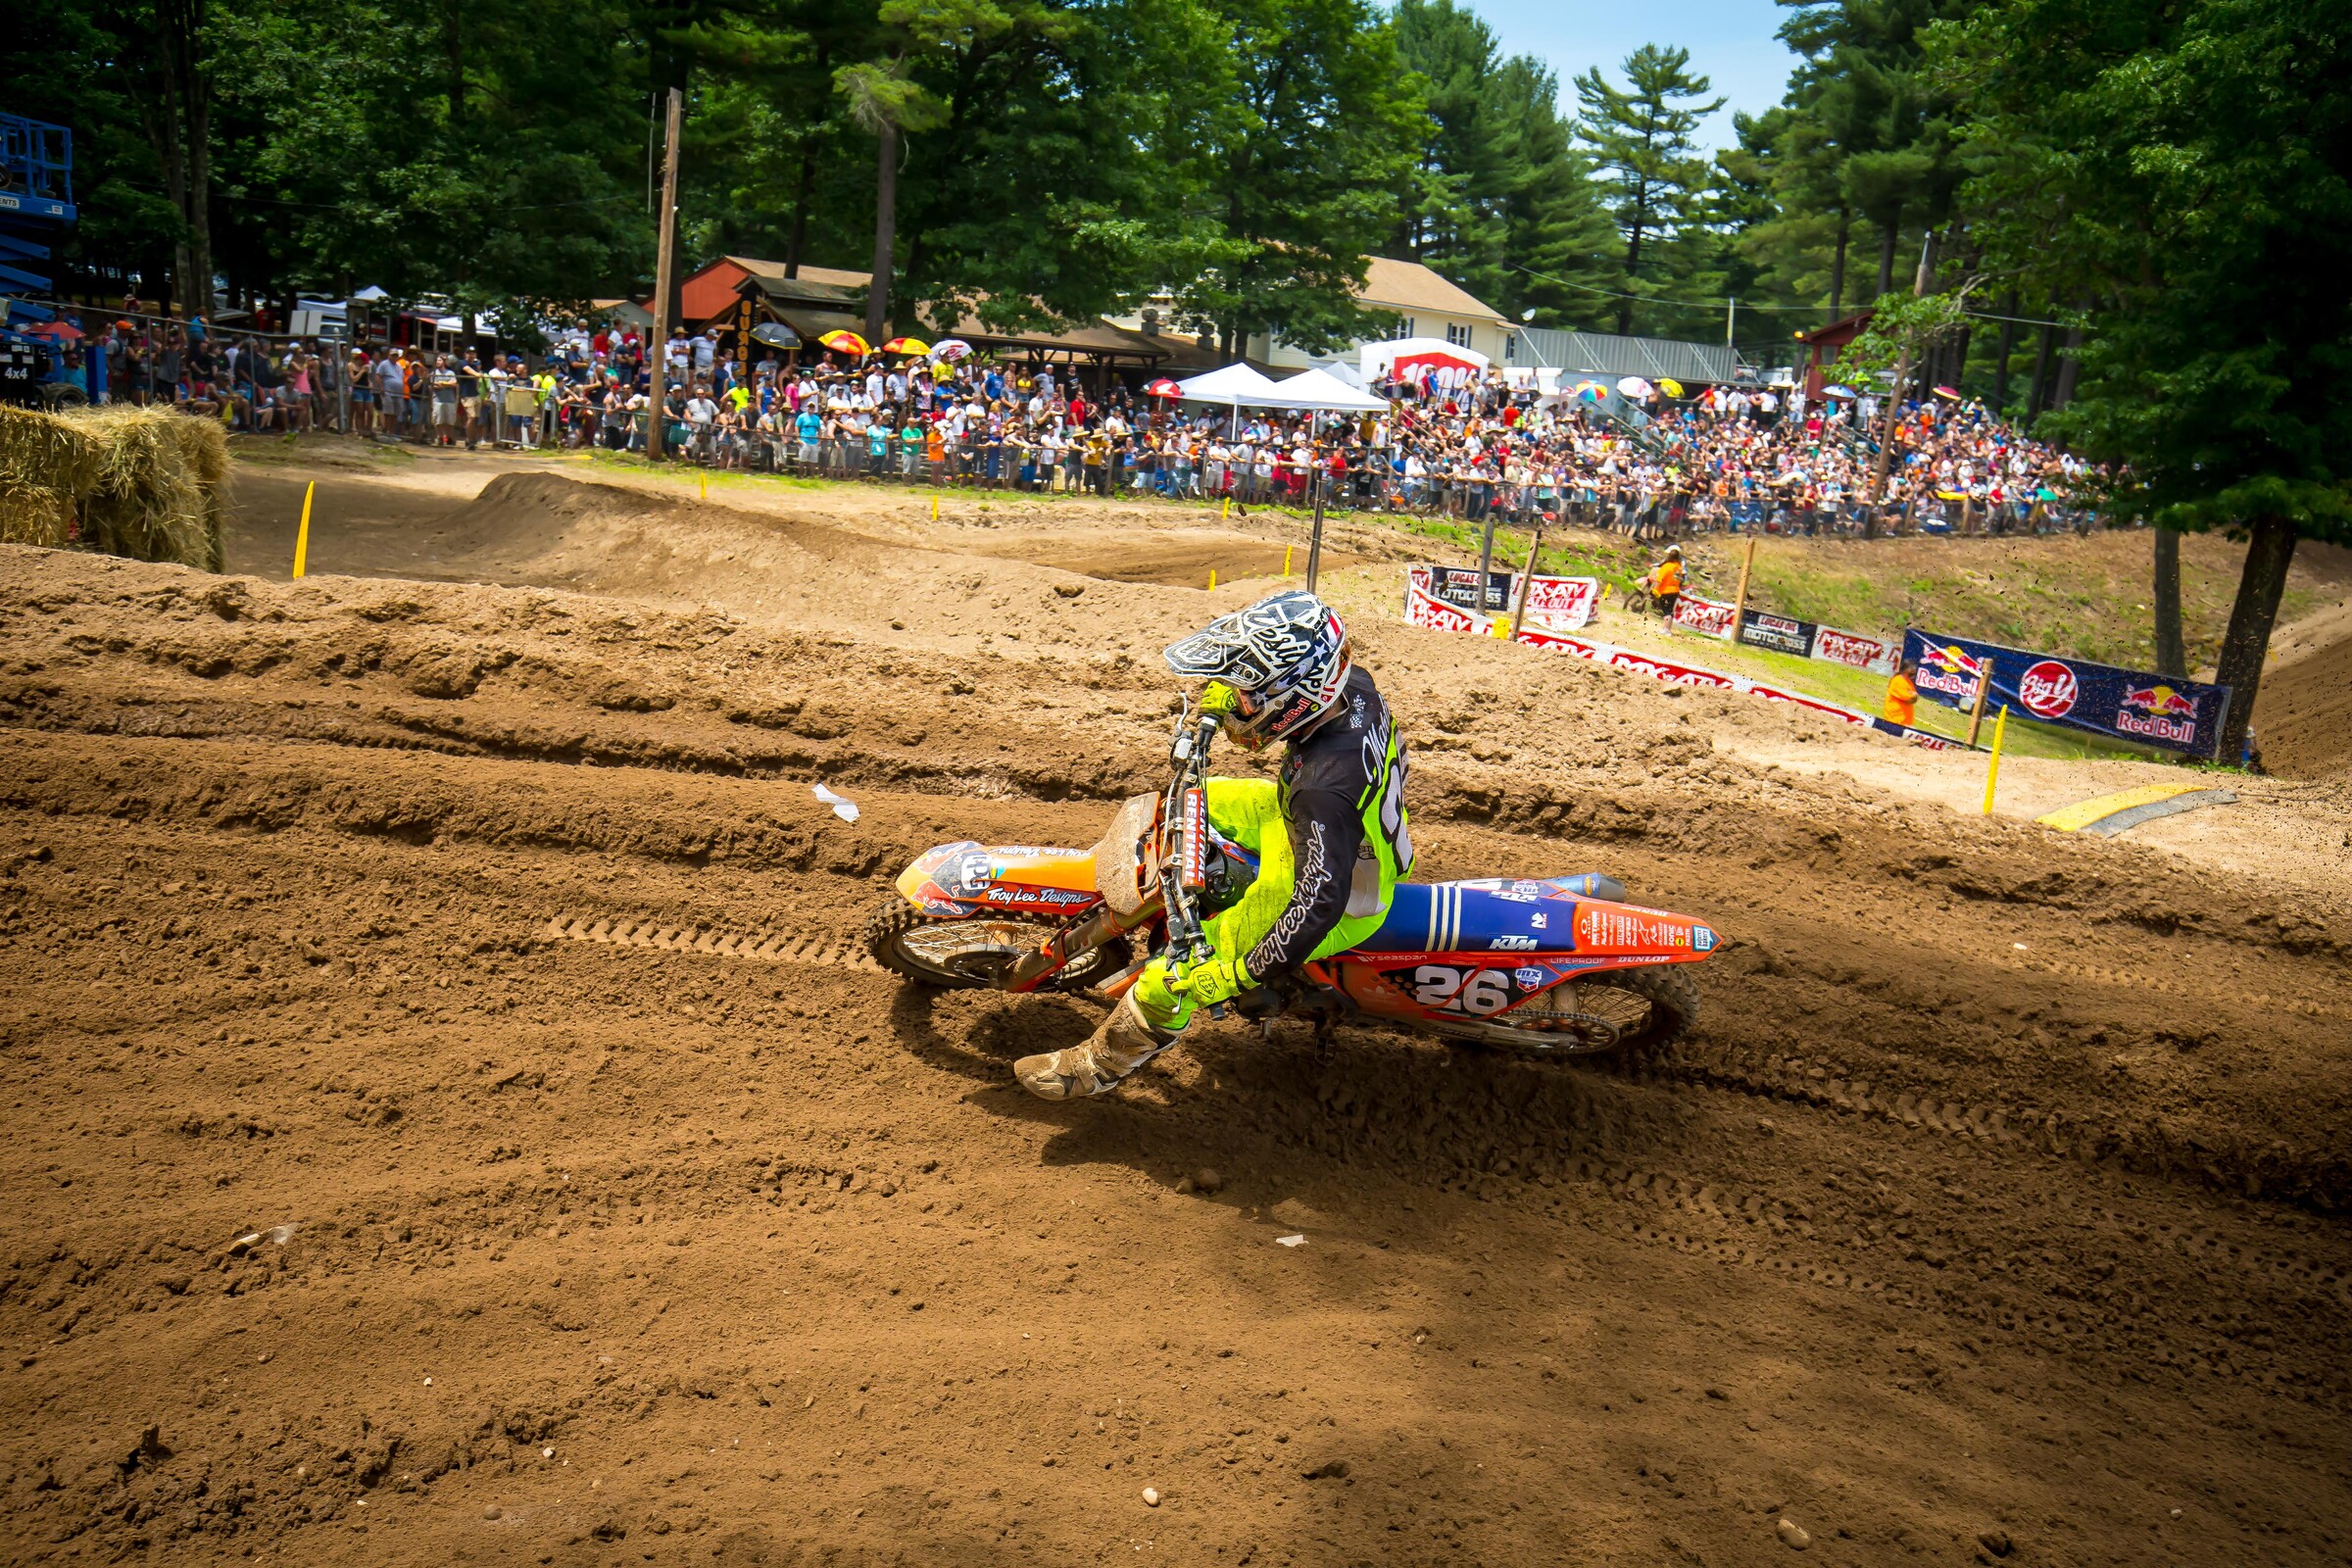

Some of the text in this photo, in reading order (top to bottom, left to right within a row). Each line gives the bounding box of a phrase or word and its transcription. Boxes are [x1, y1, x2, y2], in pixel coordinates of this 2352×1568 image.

[4, 367, 28, 379] 4x4
[1449, 571, 1475, 584] LUCAS
[1549, 583, 1589, 600] ATV
[1547, 598, 1574, 610] OUT
[1674, 598, 1702, 618] MX
[1702, 607, 1736, 622] ATV
[1430, 610, 1473, 632] ATV
[1916, 667, 1949, 692] Red
[2023, 674, 2051, 703] Big
[1271, 714, 1296, 732] Red
[1287, 697, 1312, 719] Bull
[2116, 710, 2195, 744] Red Bull
[1185, 793, 1198, 882] RENTHAL
[987, 887, 1093, 908] Troy Lee Designs
[1247, 820, 1334, 976] Troy Lee Designs
[1489, 935, 1539, 951] KTM
[1415, 964, 1509, 1016] 26
